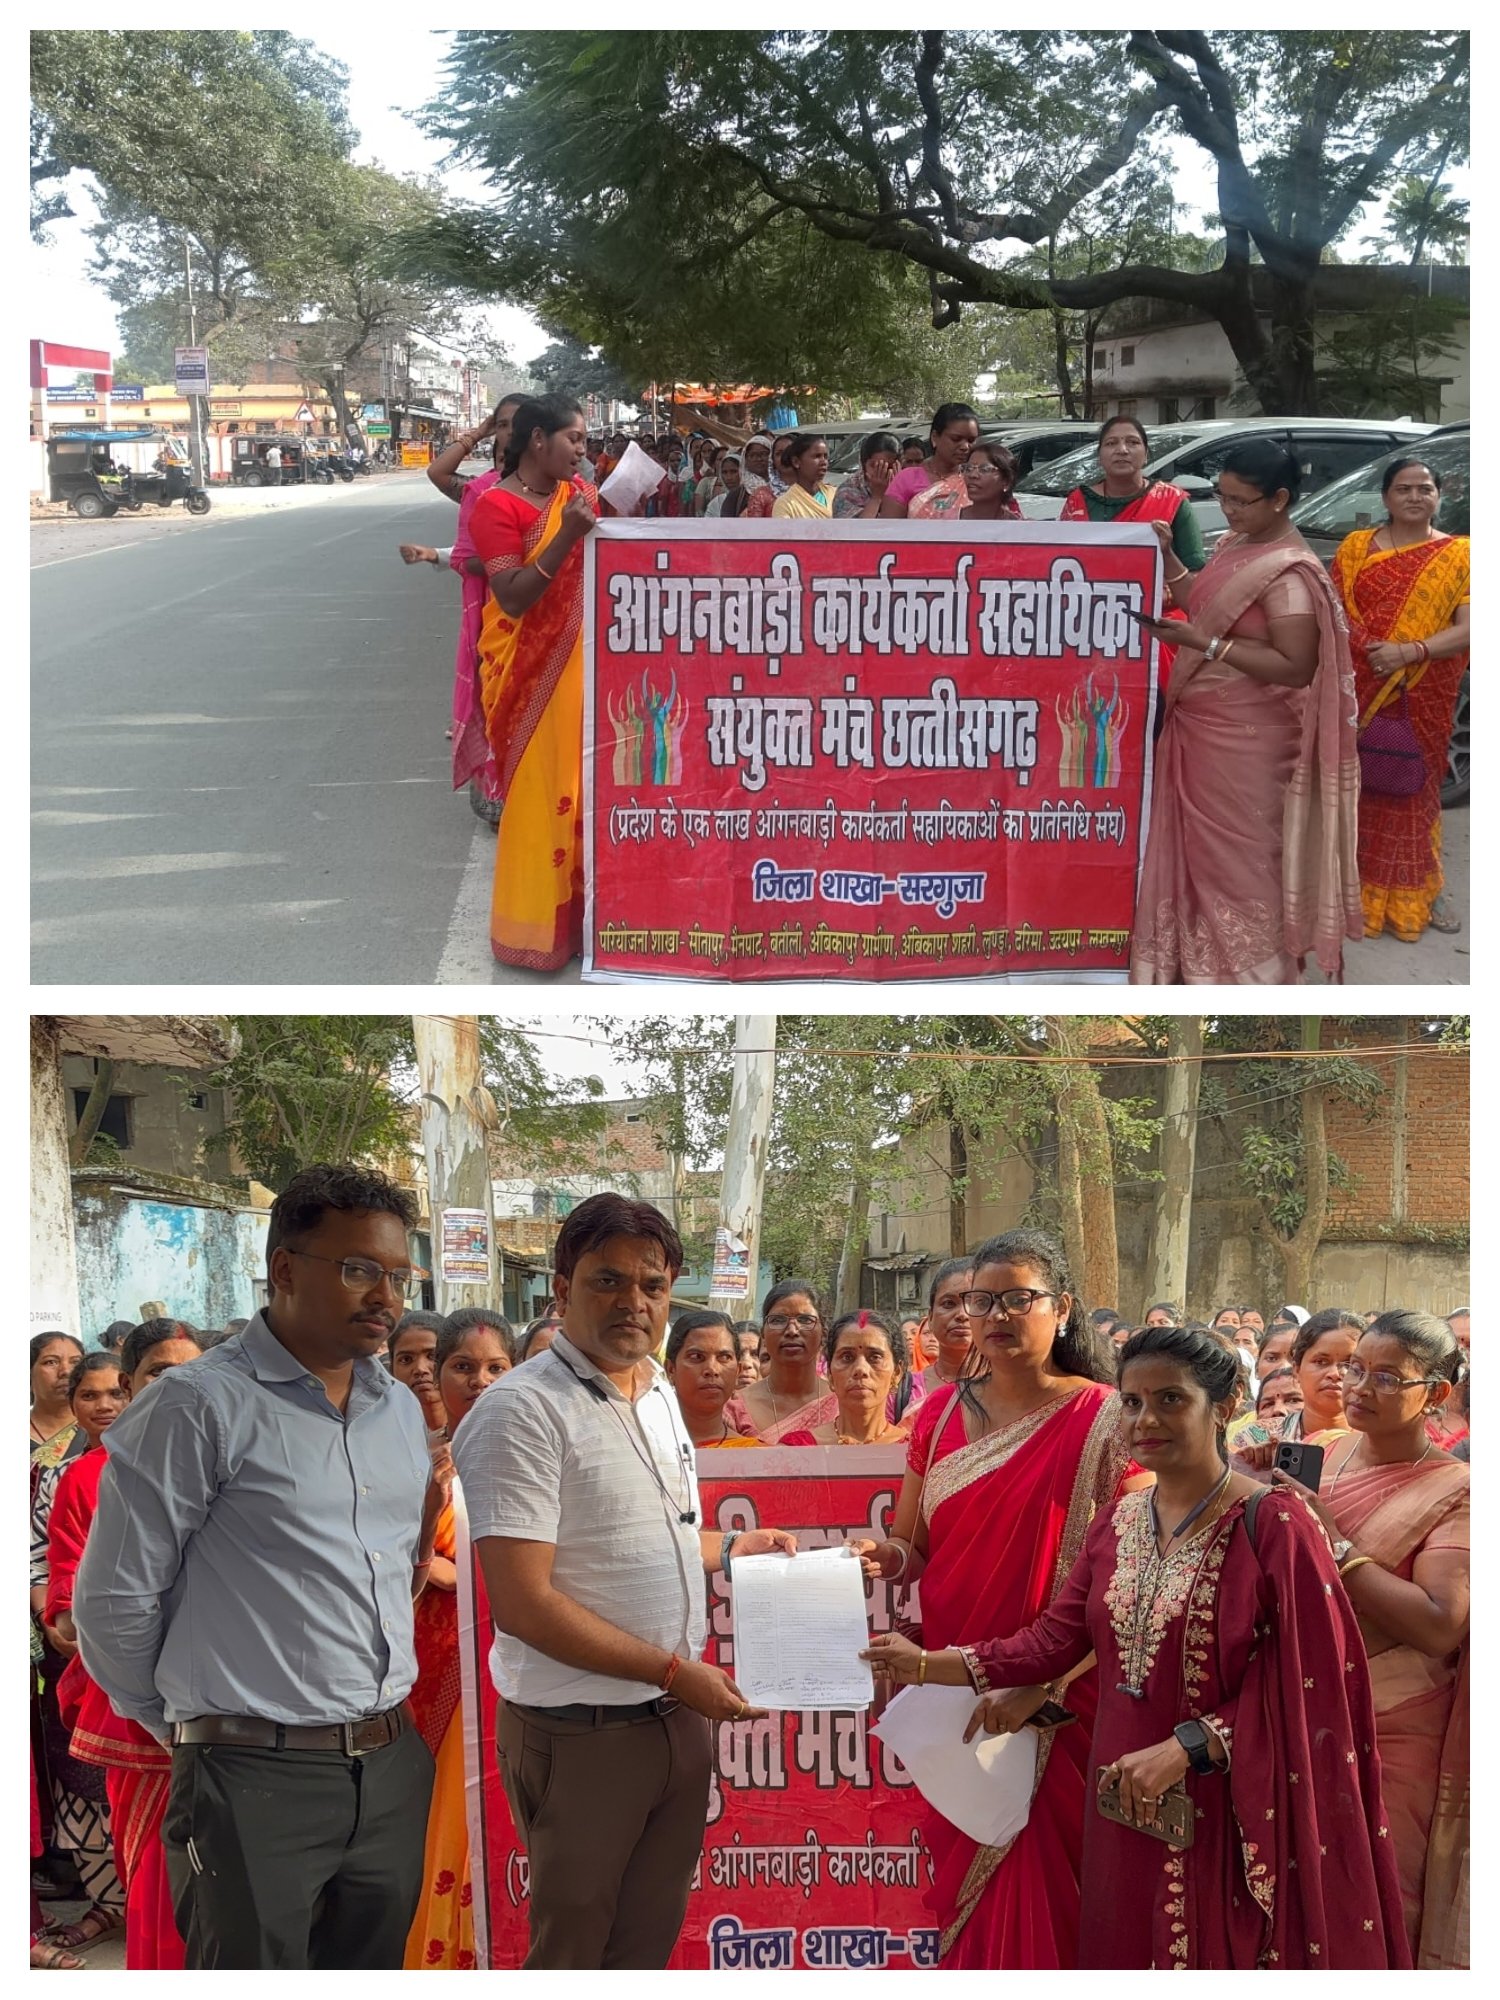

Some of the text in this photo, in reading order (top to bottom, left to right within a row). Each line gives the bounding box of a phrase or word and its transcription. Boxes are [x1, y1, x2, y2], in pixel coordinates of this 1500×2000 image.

[607, 551, 1143, 675] आंगनबाड़ी कार्यकर्ता सहायिका
[707, 675, 1039, 791] संयुक्त मंच छत्तीसगढ़
[609, 797, 1126, 849] (प्रदेश के एक लाख आंगनबाड़ी कार्यकर्ता सहायिकाओं का प्रतिनिधि संघ)
[754, 860, 816, 902] जिला
[599, 921, 649, 954] परियोजना
[709, 1829, 822, 1898] आंगनबाड़ी
[825, 1827, 921, 1888] कार्यकर्ता
[711, 1917, 794, 1970] जिला
